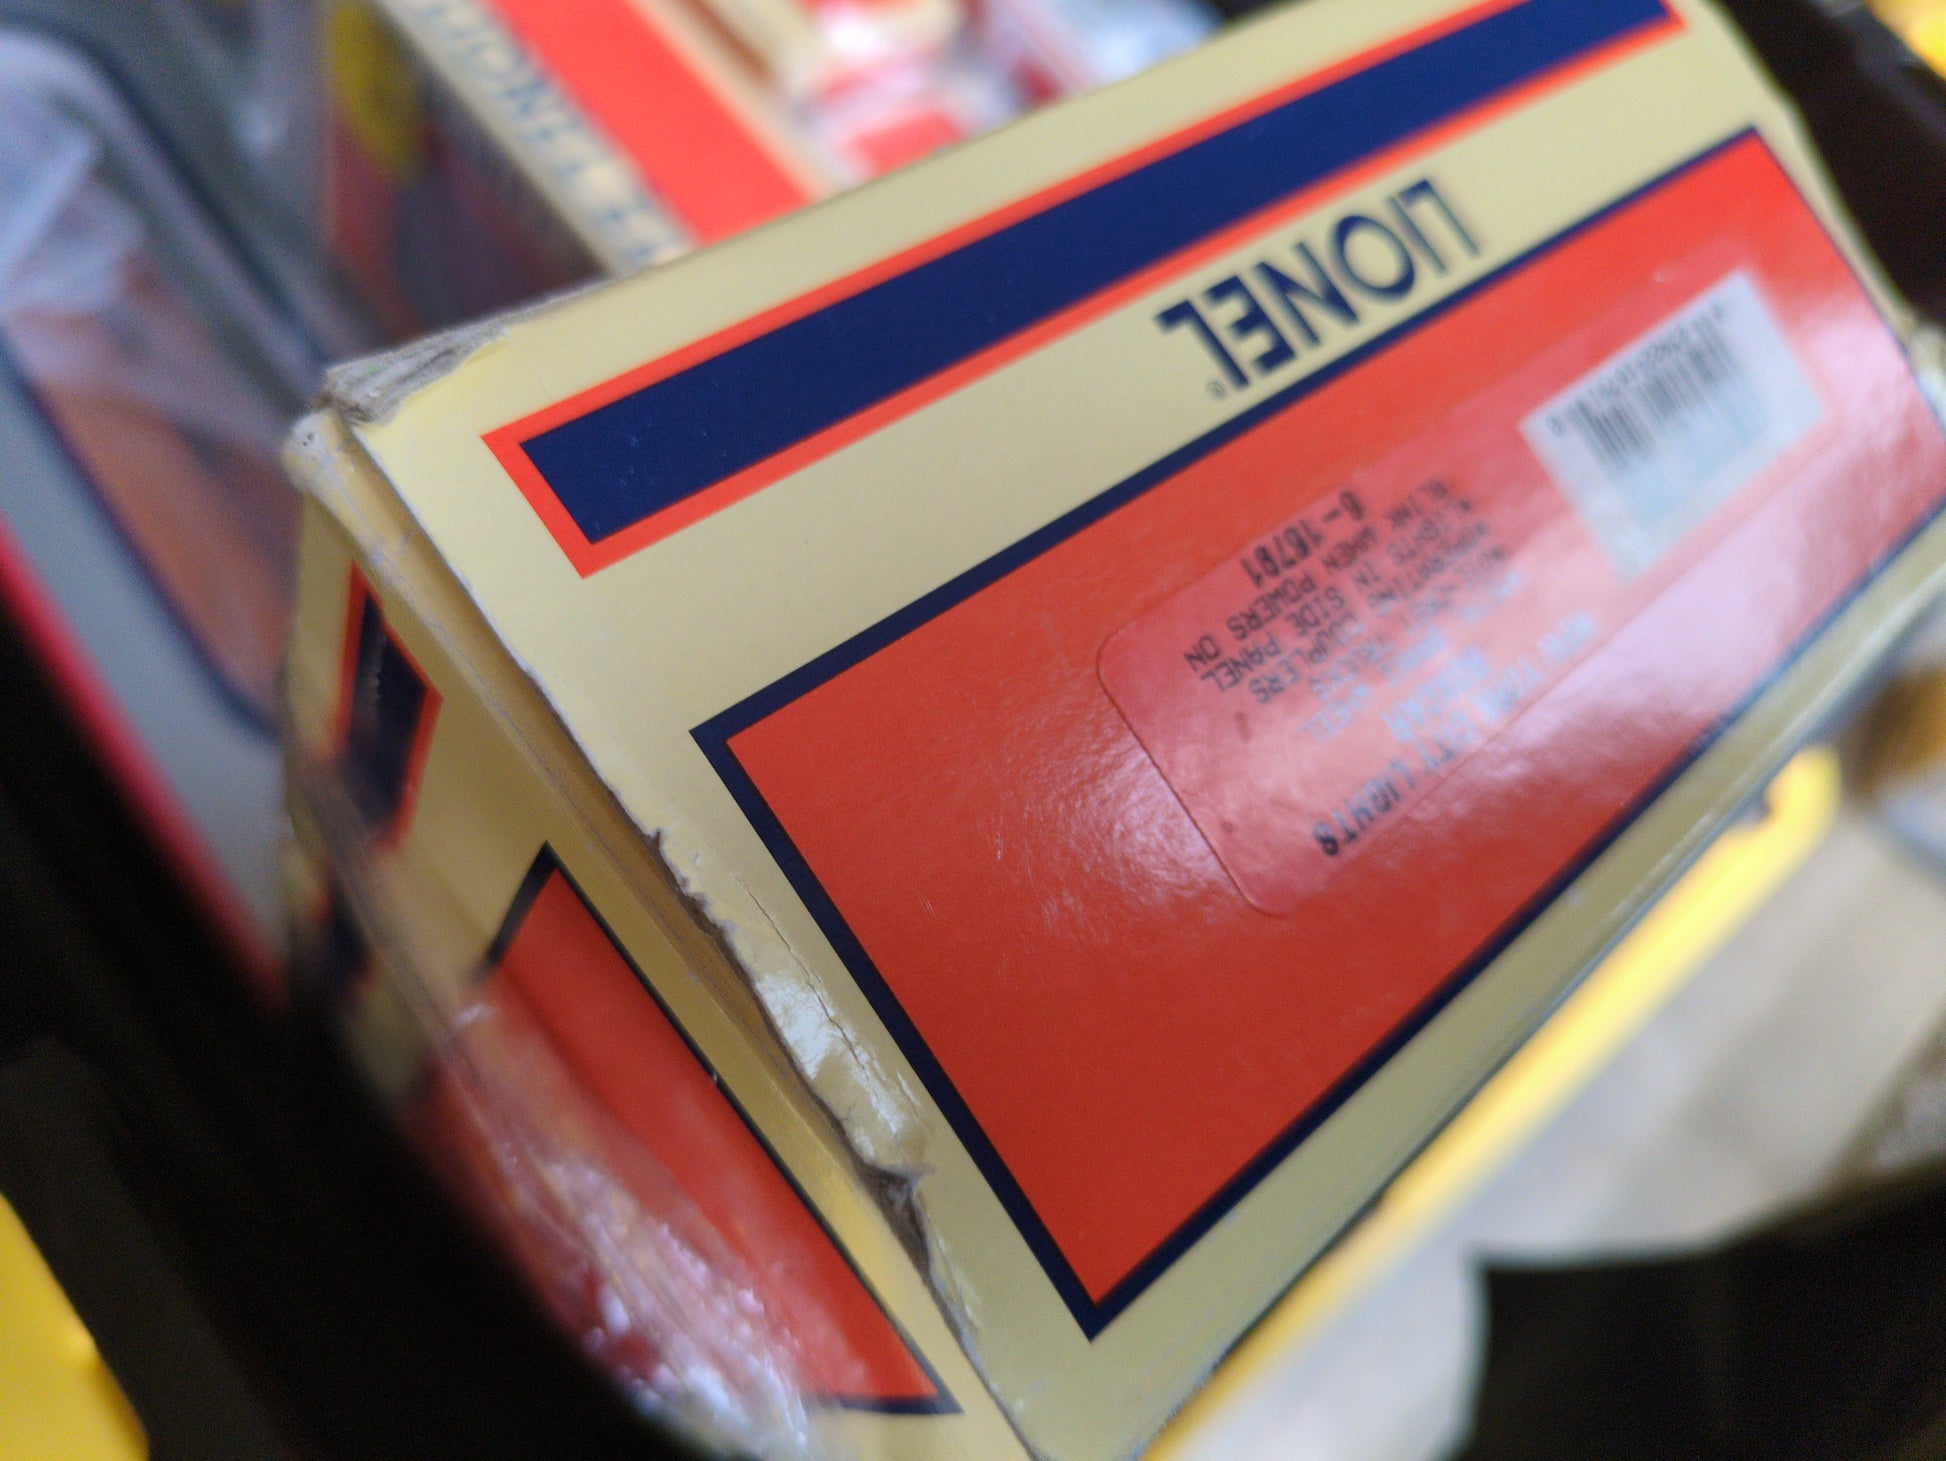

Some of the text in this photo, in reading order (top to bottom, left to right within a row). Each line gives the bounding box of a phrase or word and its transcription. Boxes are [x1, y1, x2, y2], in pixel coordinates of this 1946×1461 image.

[1153, 177, 1482, 392] LIONEL
[1318, 523, 1380, 577] WHEN
[1348, 559, 1382, 595] IN
[1223, 566, 1319, 644] POWERS
[1282, 582, 1348, 641] SIDE
[1181, 631, 1223, 675] ON
[1198, 628, 1282, 700] PANEL
[1245, 609, 1365, 707] COUPLERS
[1378, 643, 1491, 745] BOXCAR
[1308, 756, 1416, 858] LIGHTS
